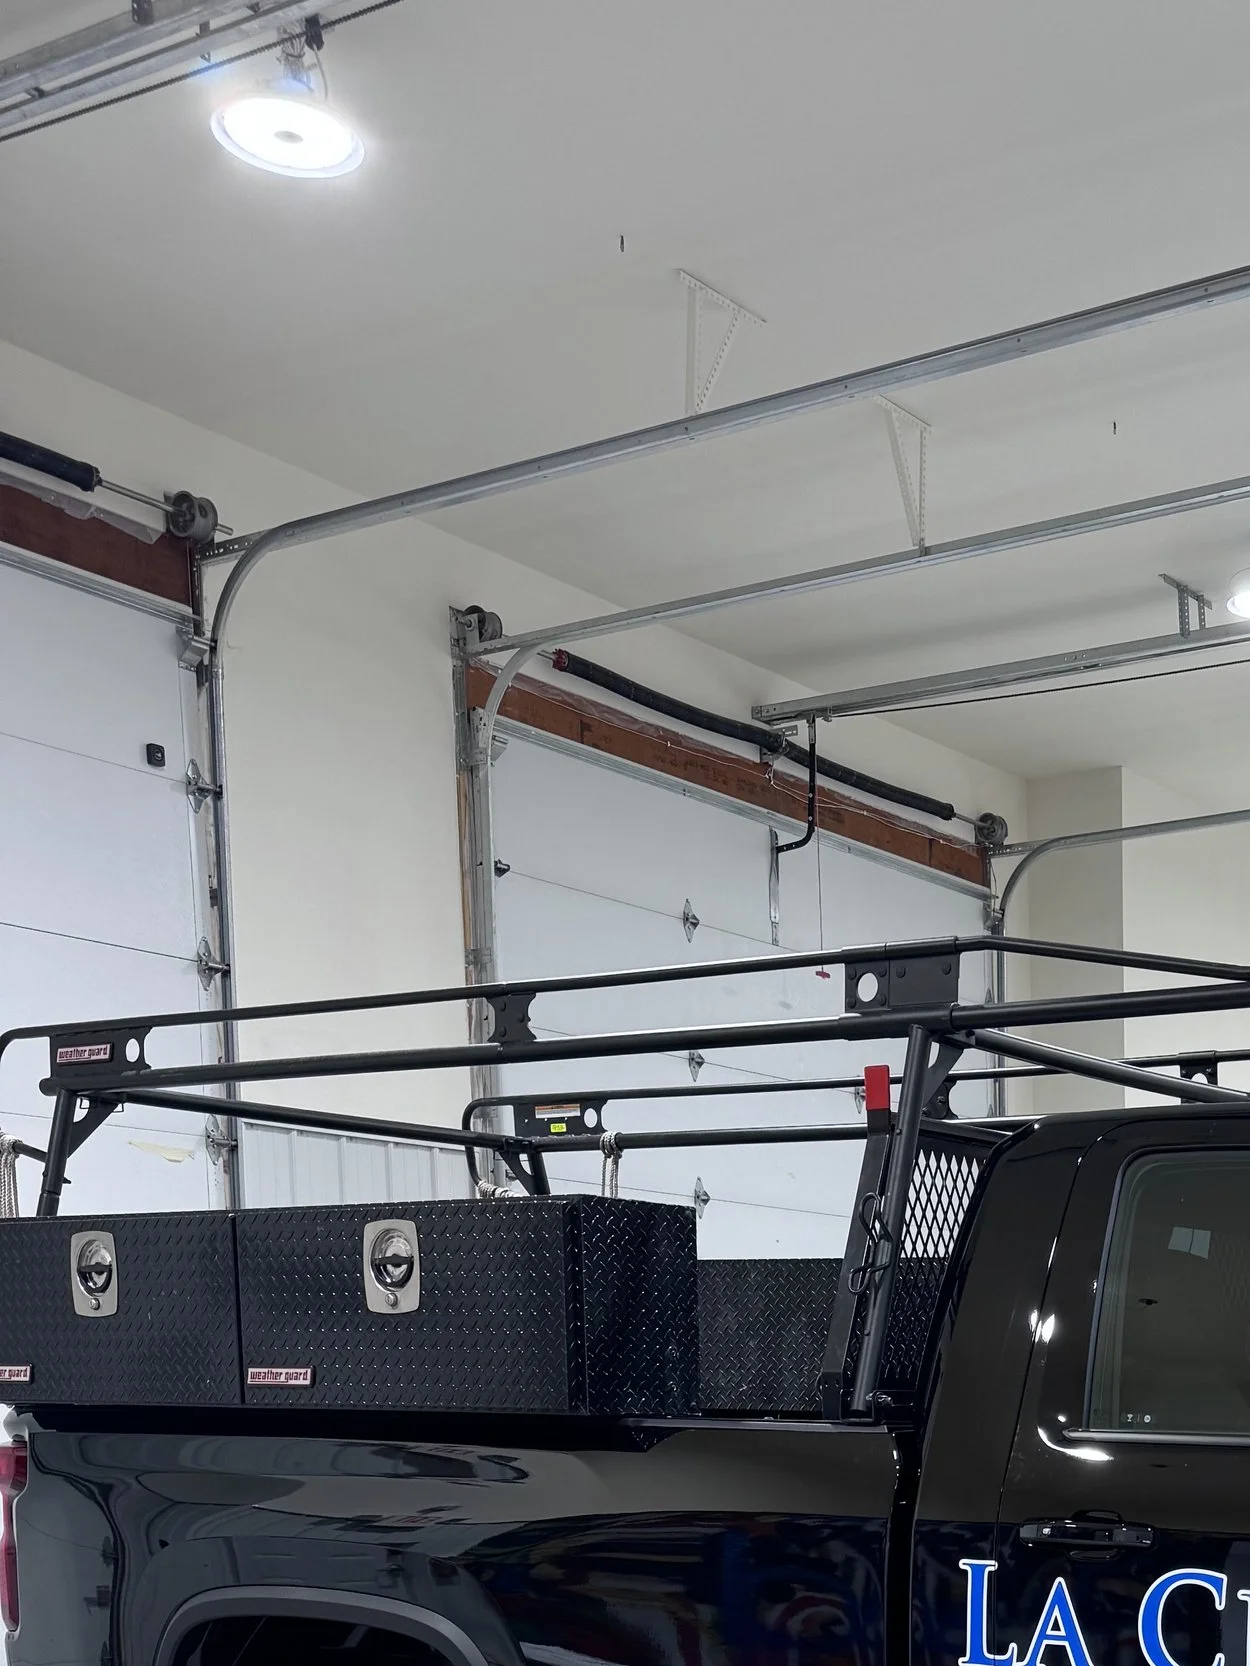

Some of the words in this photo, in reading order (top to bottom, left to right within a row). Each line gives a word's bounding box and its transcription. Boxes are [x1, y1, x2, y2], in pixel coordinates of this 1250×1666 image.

[58, 1047, 87, 1060] weather
[88, 1045, 108, 1058] guard
[249, 1369, 283, 1381] weather
[284, 1369, 308, 1382] guard
